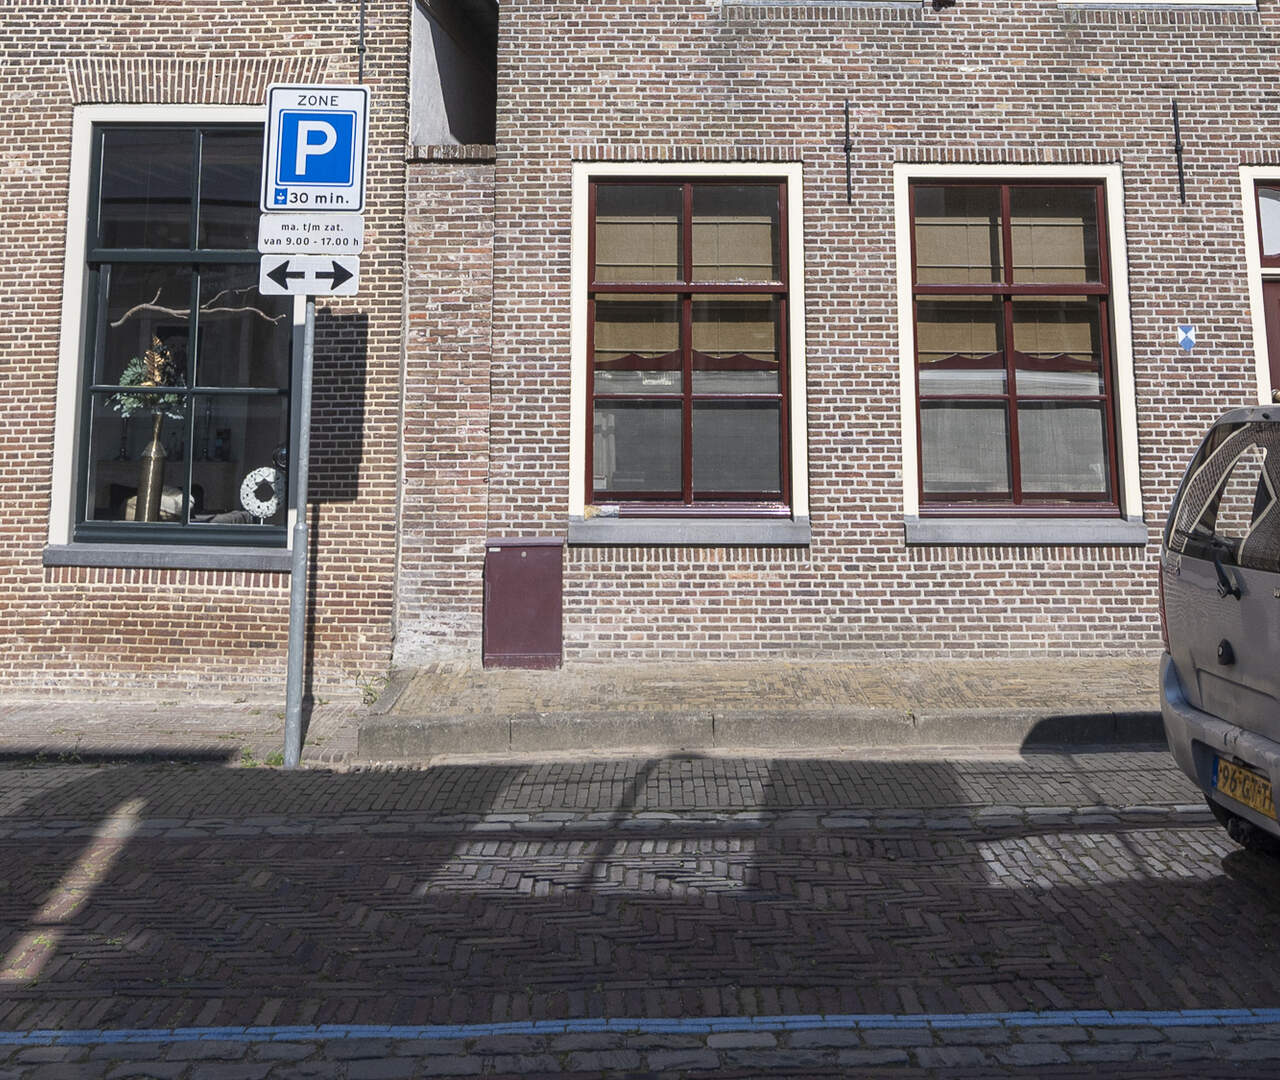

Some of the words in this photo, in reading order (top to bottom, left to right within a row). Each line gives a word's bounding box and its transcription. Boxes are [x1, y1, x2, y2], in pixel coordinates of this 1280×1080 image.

[297, 95, 339, 107] ZONE
[295, 120, 338, 176] P
[289, 192, 309, 204] 30
[315, 192, 349, 204] min.
[281, 223, 299, 231] ma.
[303, 222, 320, 233] t/m
[324, 223, 344, 232] zat.
[263, 238, 282, 246] van
[286, 237, 310, 246] 9.00
[321, 237, 349, 246] 17.00
[353, 237, 359, 246] h
